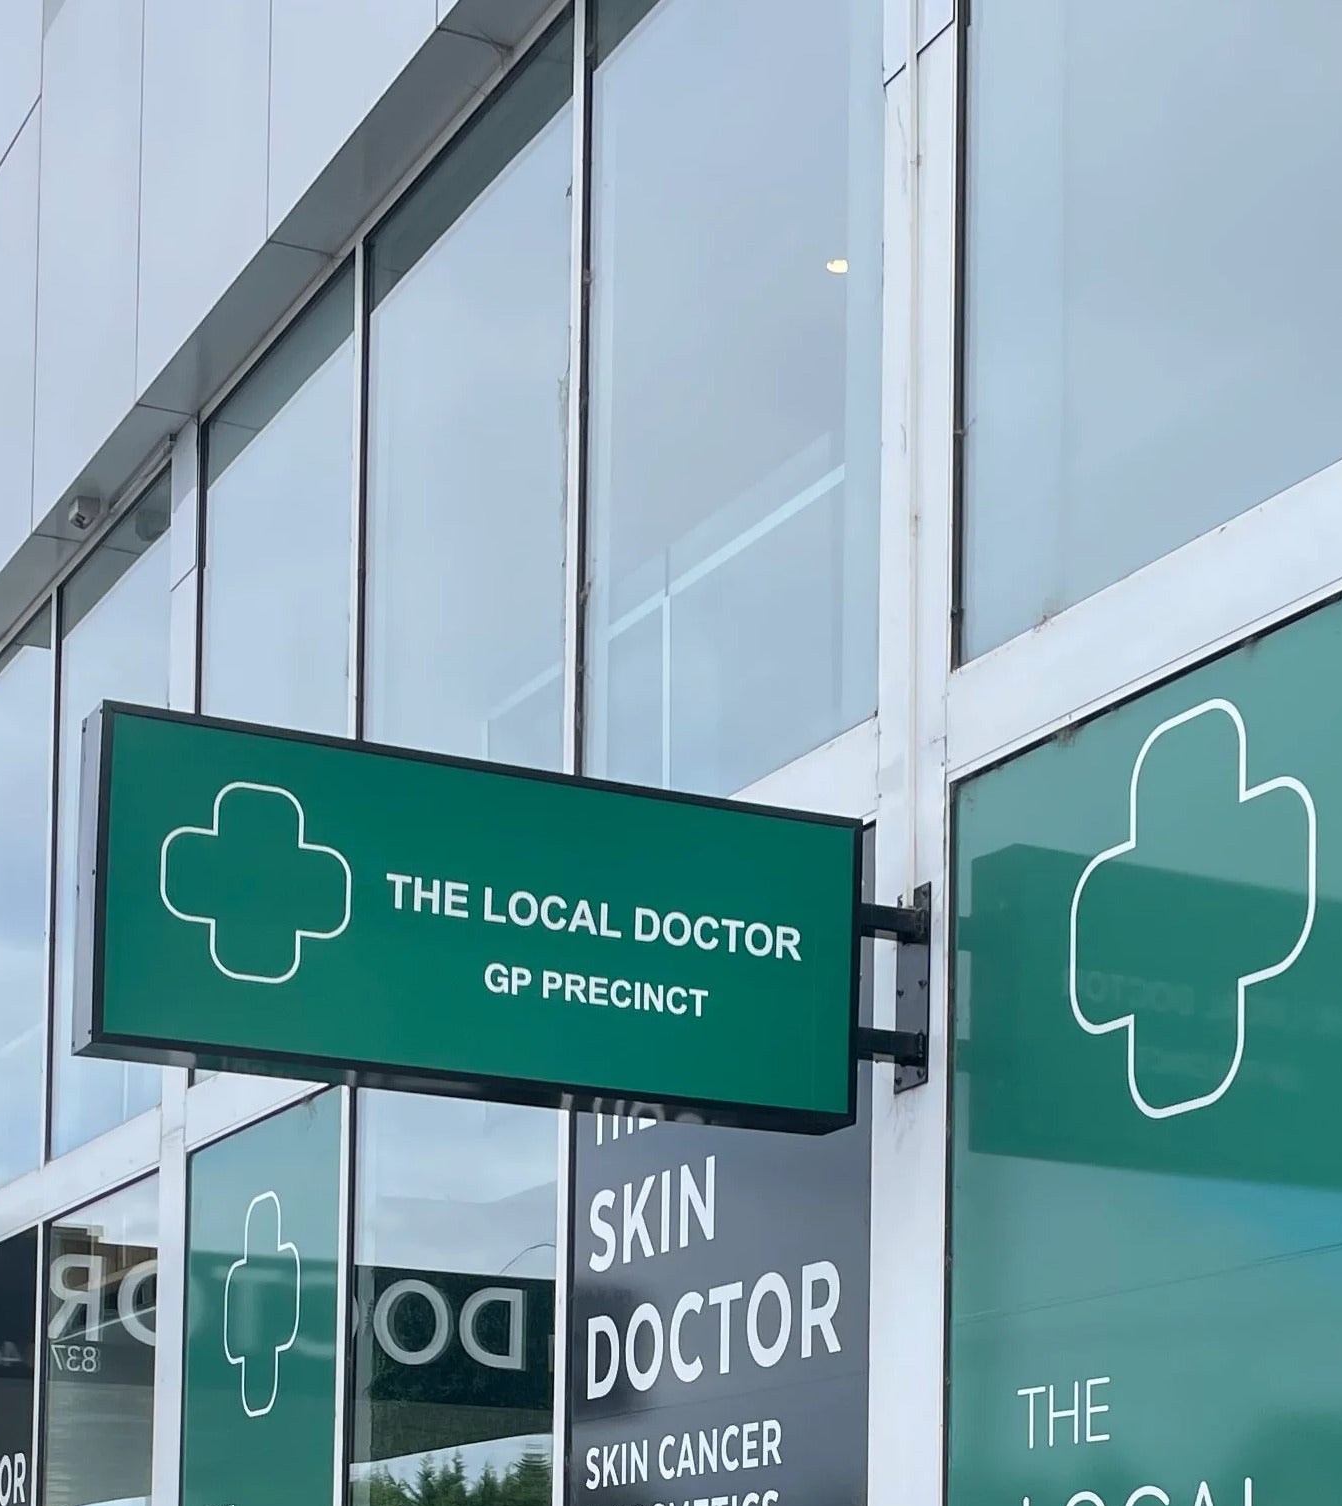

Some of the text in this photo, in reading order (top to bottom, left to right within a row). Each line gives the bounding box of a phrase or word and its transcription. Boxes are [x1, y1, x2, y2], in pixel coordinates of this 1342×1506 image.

[387, 873, 802, 961] THE LOCAL DOCTOR
[484, 962, 709, 1018] GP PRECINCT
[588, 1155, 716, 1273] SKIN
[586, 1260, 841, 1400] DOCTOR
[1017, 1376, 1111, 1449] THE
[585, 1419, 783, 1490] SKIN CANCER
